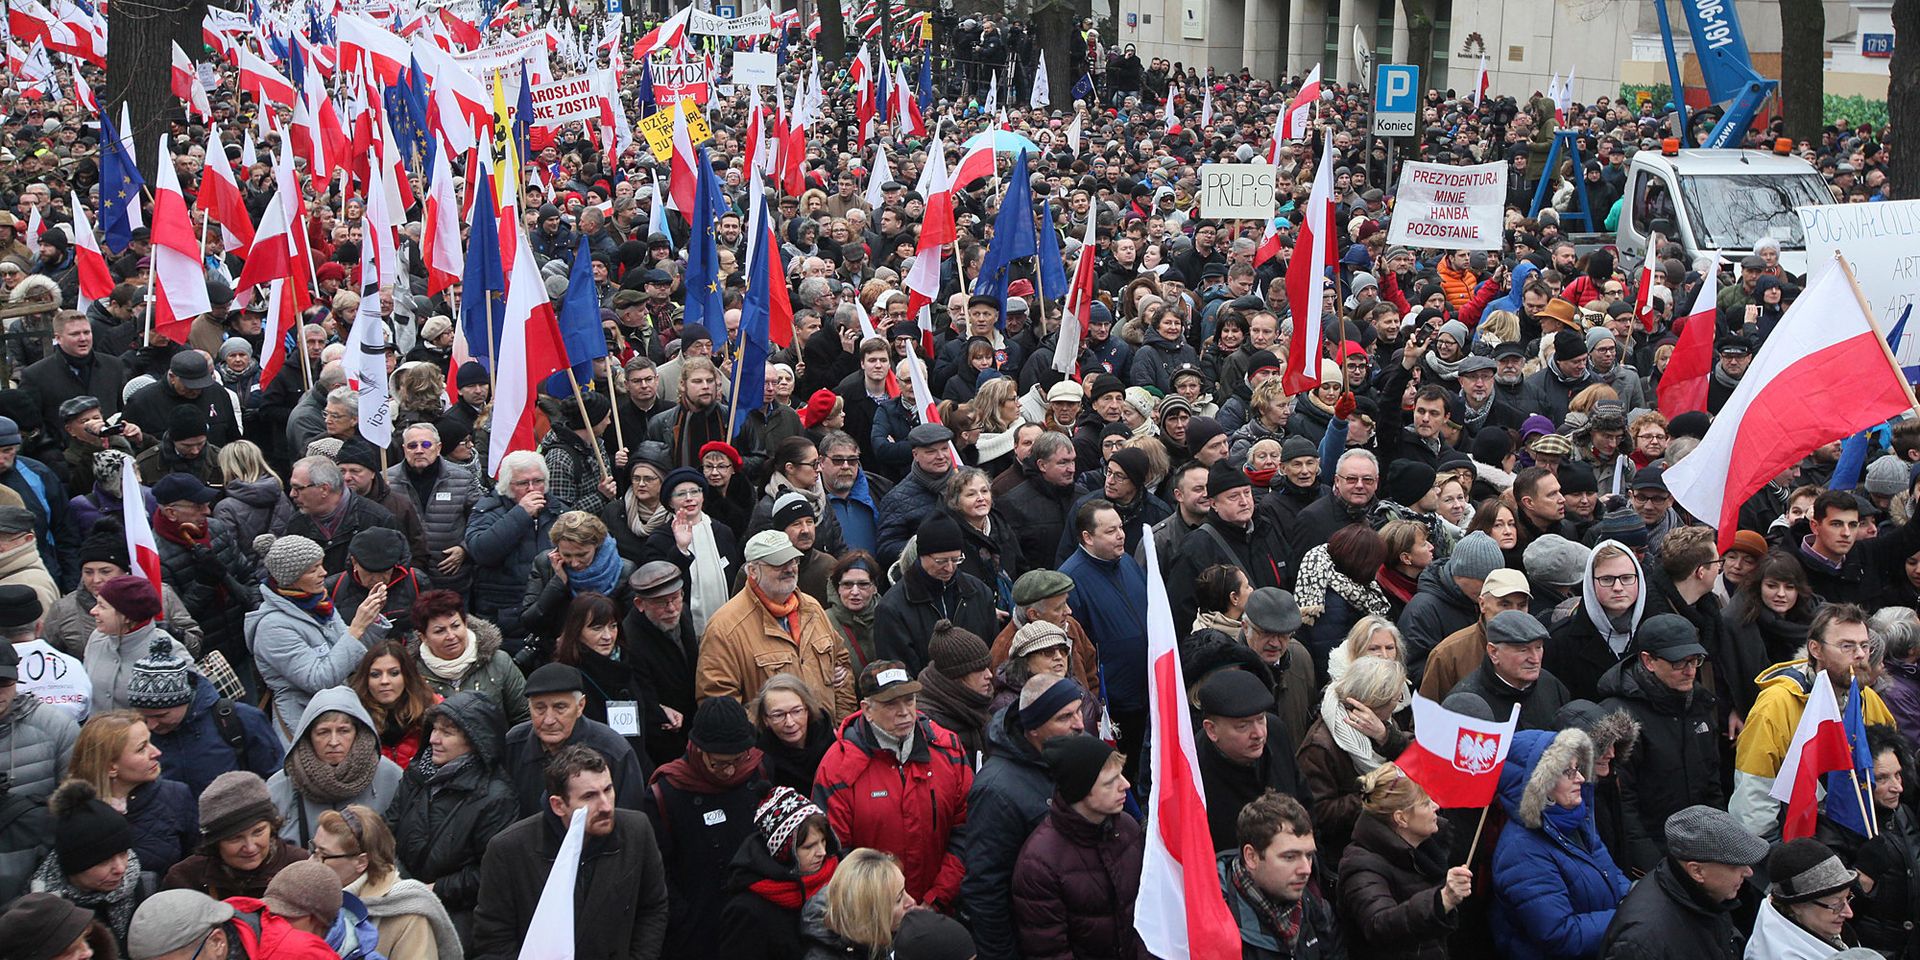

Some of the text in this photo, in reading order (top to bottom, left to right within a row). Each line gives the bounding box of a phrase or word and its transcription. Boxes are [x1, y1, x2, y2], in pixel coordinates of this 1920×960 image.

[693, 15, 724, 32] STOP
[1695, 0, 1733, 50] 06-191
[530, 79, 591, 104] AROSŁAW
[1385, 70, 1410, 107] P
[507, 104, 556, 120] PSKĘ
[1377, 119, 1413, 131] Koniec
[1712, 121, 1736, 149] SZAWA
[1413, 170, 1498, 187] PREZYDENTURA
[1434, 190, 1466, 204] MINIE
[1406, 222, 1479, 239] POZOSTANIE
[17, 649, 67, 684] OD
[612, 712, 634, 726] KOD
